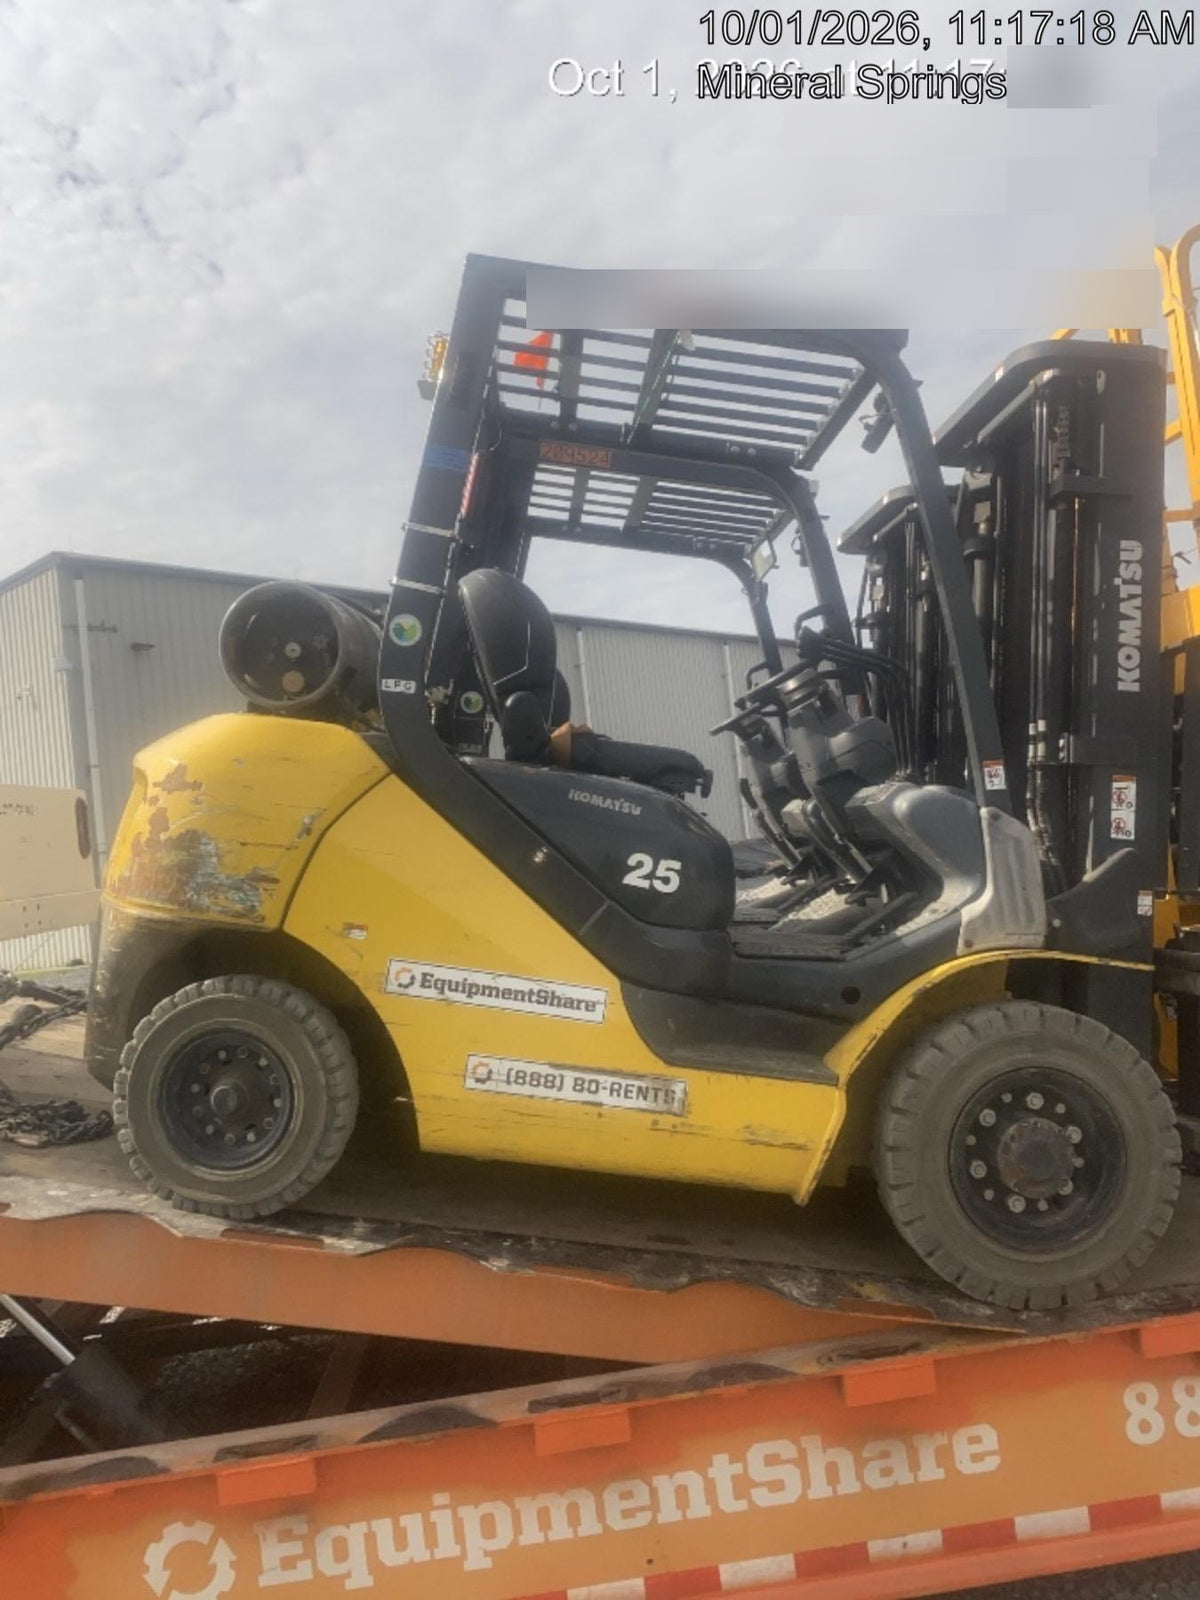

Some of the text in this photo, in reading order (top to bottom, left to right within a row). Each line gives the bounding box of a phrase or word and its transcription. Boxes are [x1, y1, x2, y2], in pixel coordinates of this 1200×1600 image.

[1113, 539, 1144, 693] KOMATSU
[568, 789, 643, 816] KOMATSU
[622, 852, 682, 894] 25
[419, 971, 597, 1013] EquipmentShare
[506, 1067, 677, 1103] (888) 80-RENTS
[255, 1420, 1001, 1590] EquipmentShare
